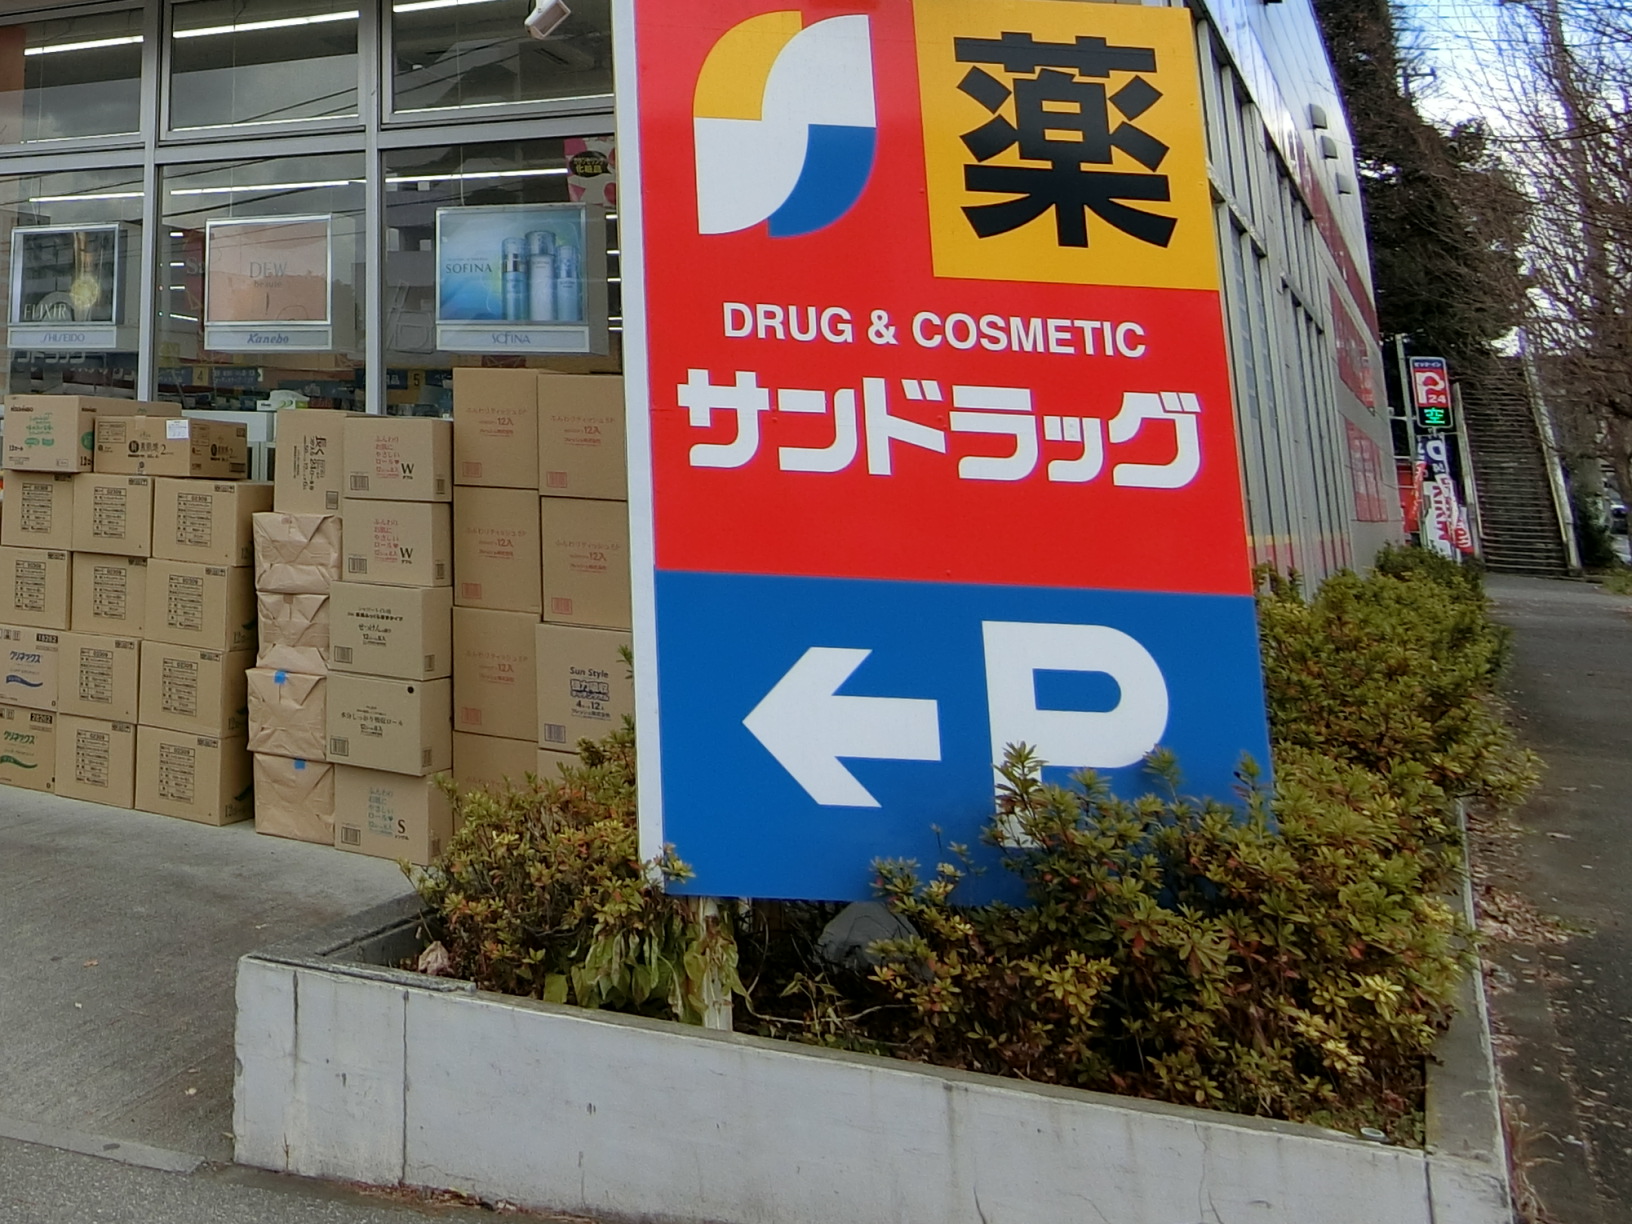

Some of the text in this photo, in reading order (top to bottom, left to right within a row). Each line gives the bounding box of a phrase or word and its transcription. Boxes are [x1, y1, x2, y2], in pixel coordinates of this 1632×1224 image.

[953, 31, 1179, 249] 薬
[249, 261, 287, 278] DEW
[445, 263, 493, 274] SOFINA
[24, 303, 67, 320] ELIXIR
[722, 301, 1147, 359] DRUG & COSMETIC
[42, 333, 85, 343] SHISEIDO
[247, 332, 289, 344] Kanebo
[1428, 394, 1447, 404] 24
[676, 368, 1203, 490] サンドラッグ
[401, 463, 415, 475] W
[400, 547, 413, 559] W
[10, 651, 41, 664] クリネックス
[570, 666, 609, 679] Sun Style
[982, 620, 1169, 849] P
[397, 819, 406, 834] S
